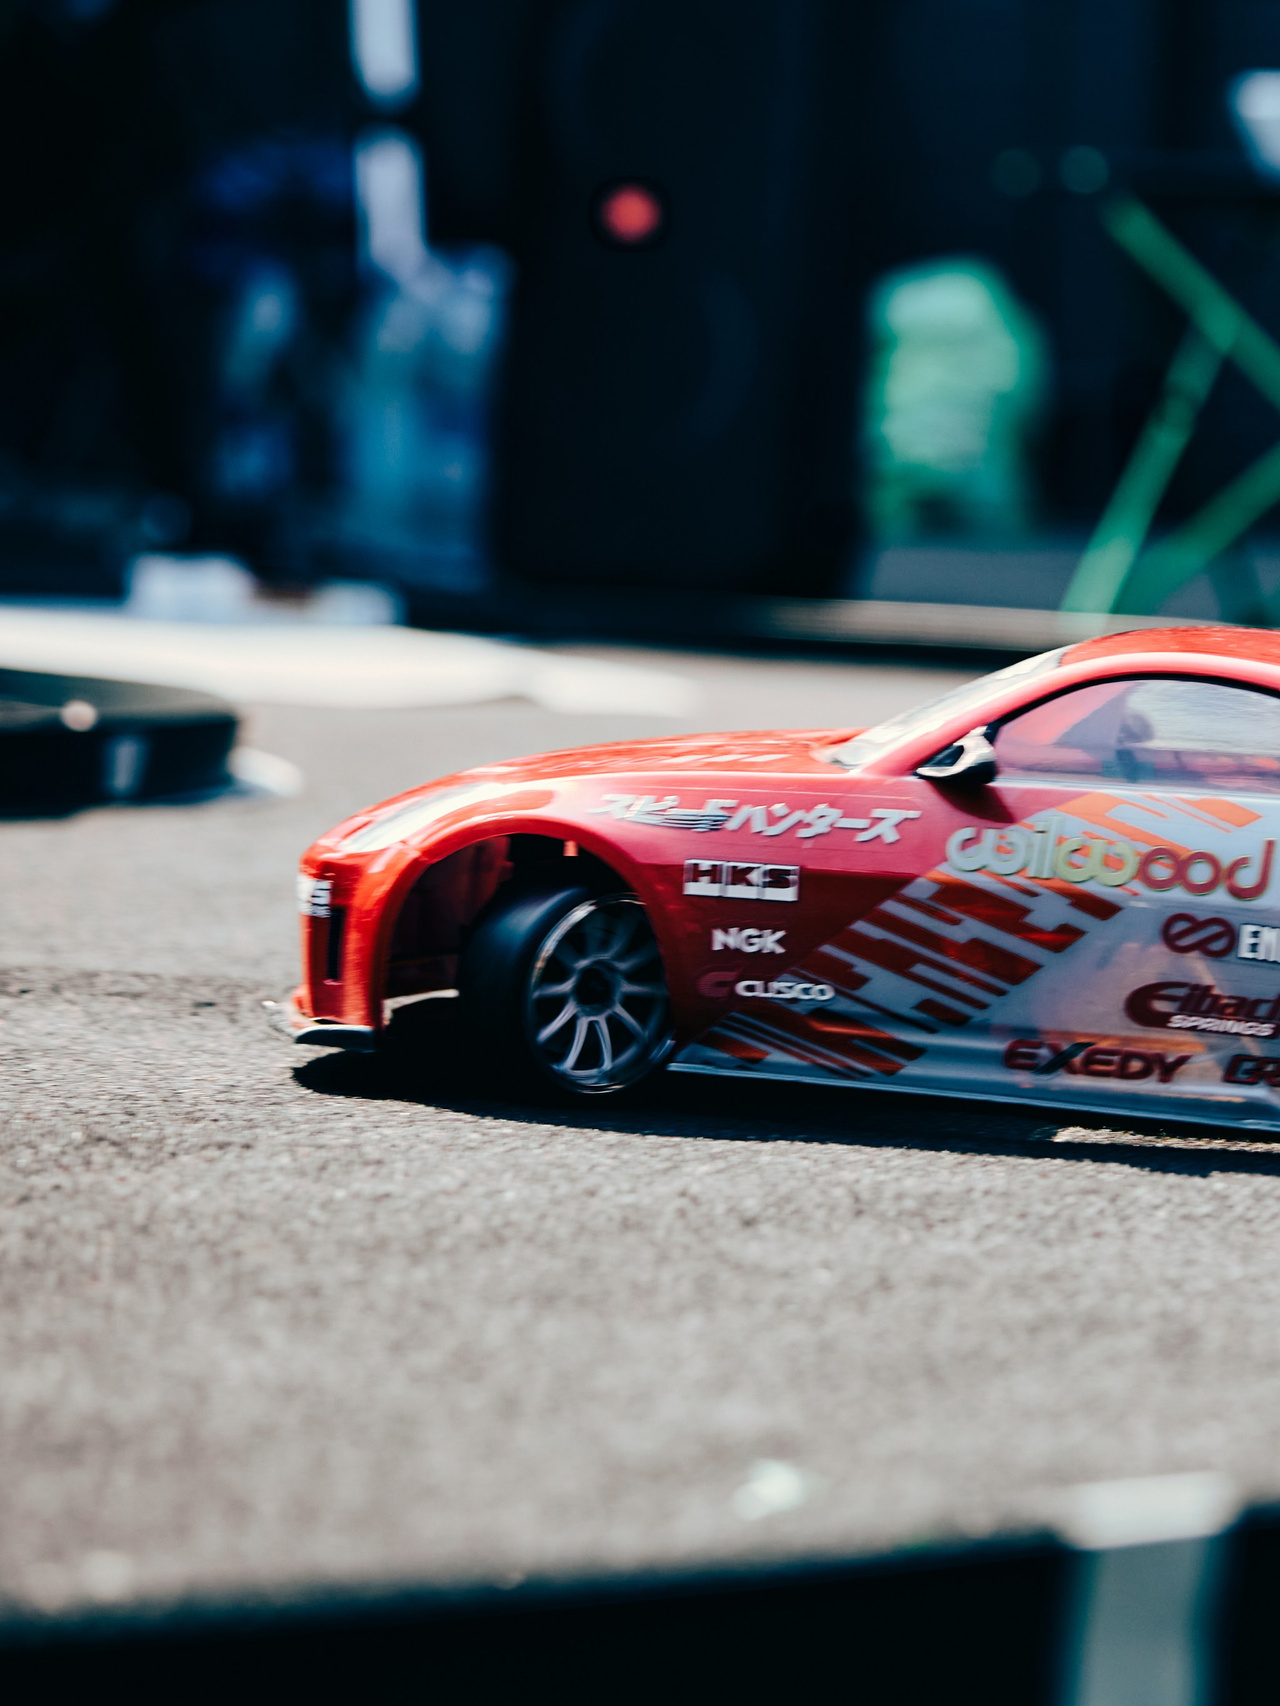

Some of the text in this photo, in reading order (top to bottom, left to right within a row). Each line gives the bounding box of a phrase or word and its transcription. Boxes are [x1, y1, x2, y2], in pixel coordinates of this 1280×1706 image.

[588, 794, 922, 844] スピードハンターズ
[946, 817, 1276, 899] wilwood
[685, 860, 799, 895] HKS
[711, 927, 787, 954] NGK
[735, 980, 836, 1001] CUSCO
[1167, 1014, 1276, 1037] SPRINGS
[1003, 1038, 1193, 1083] EXEDY
